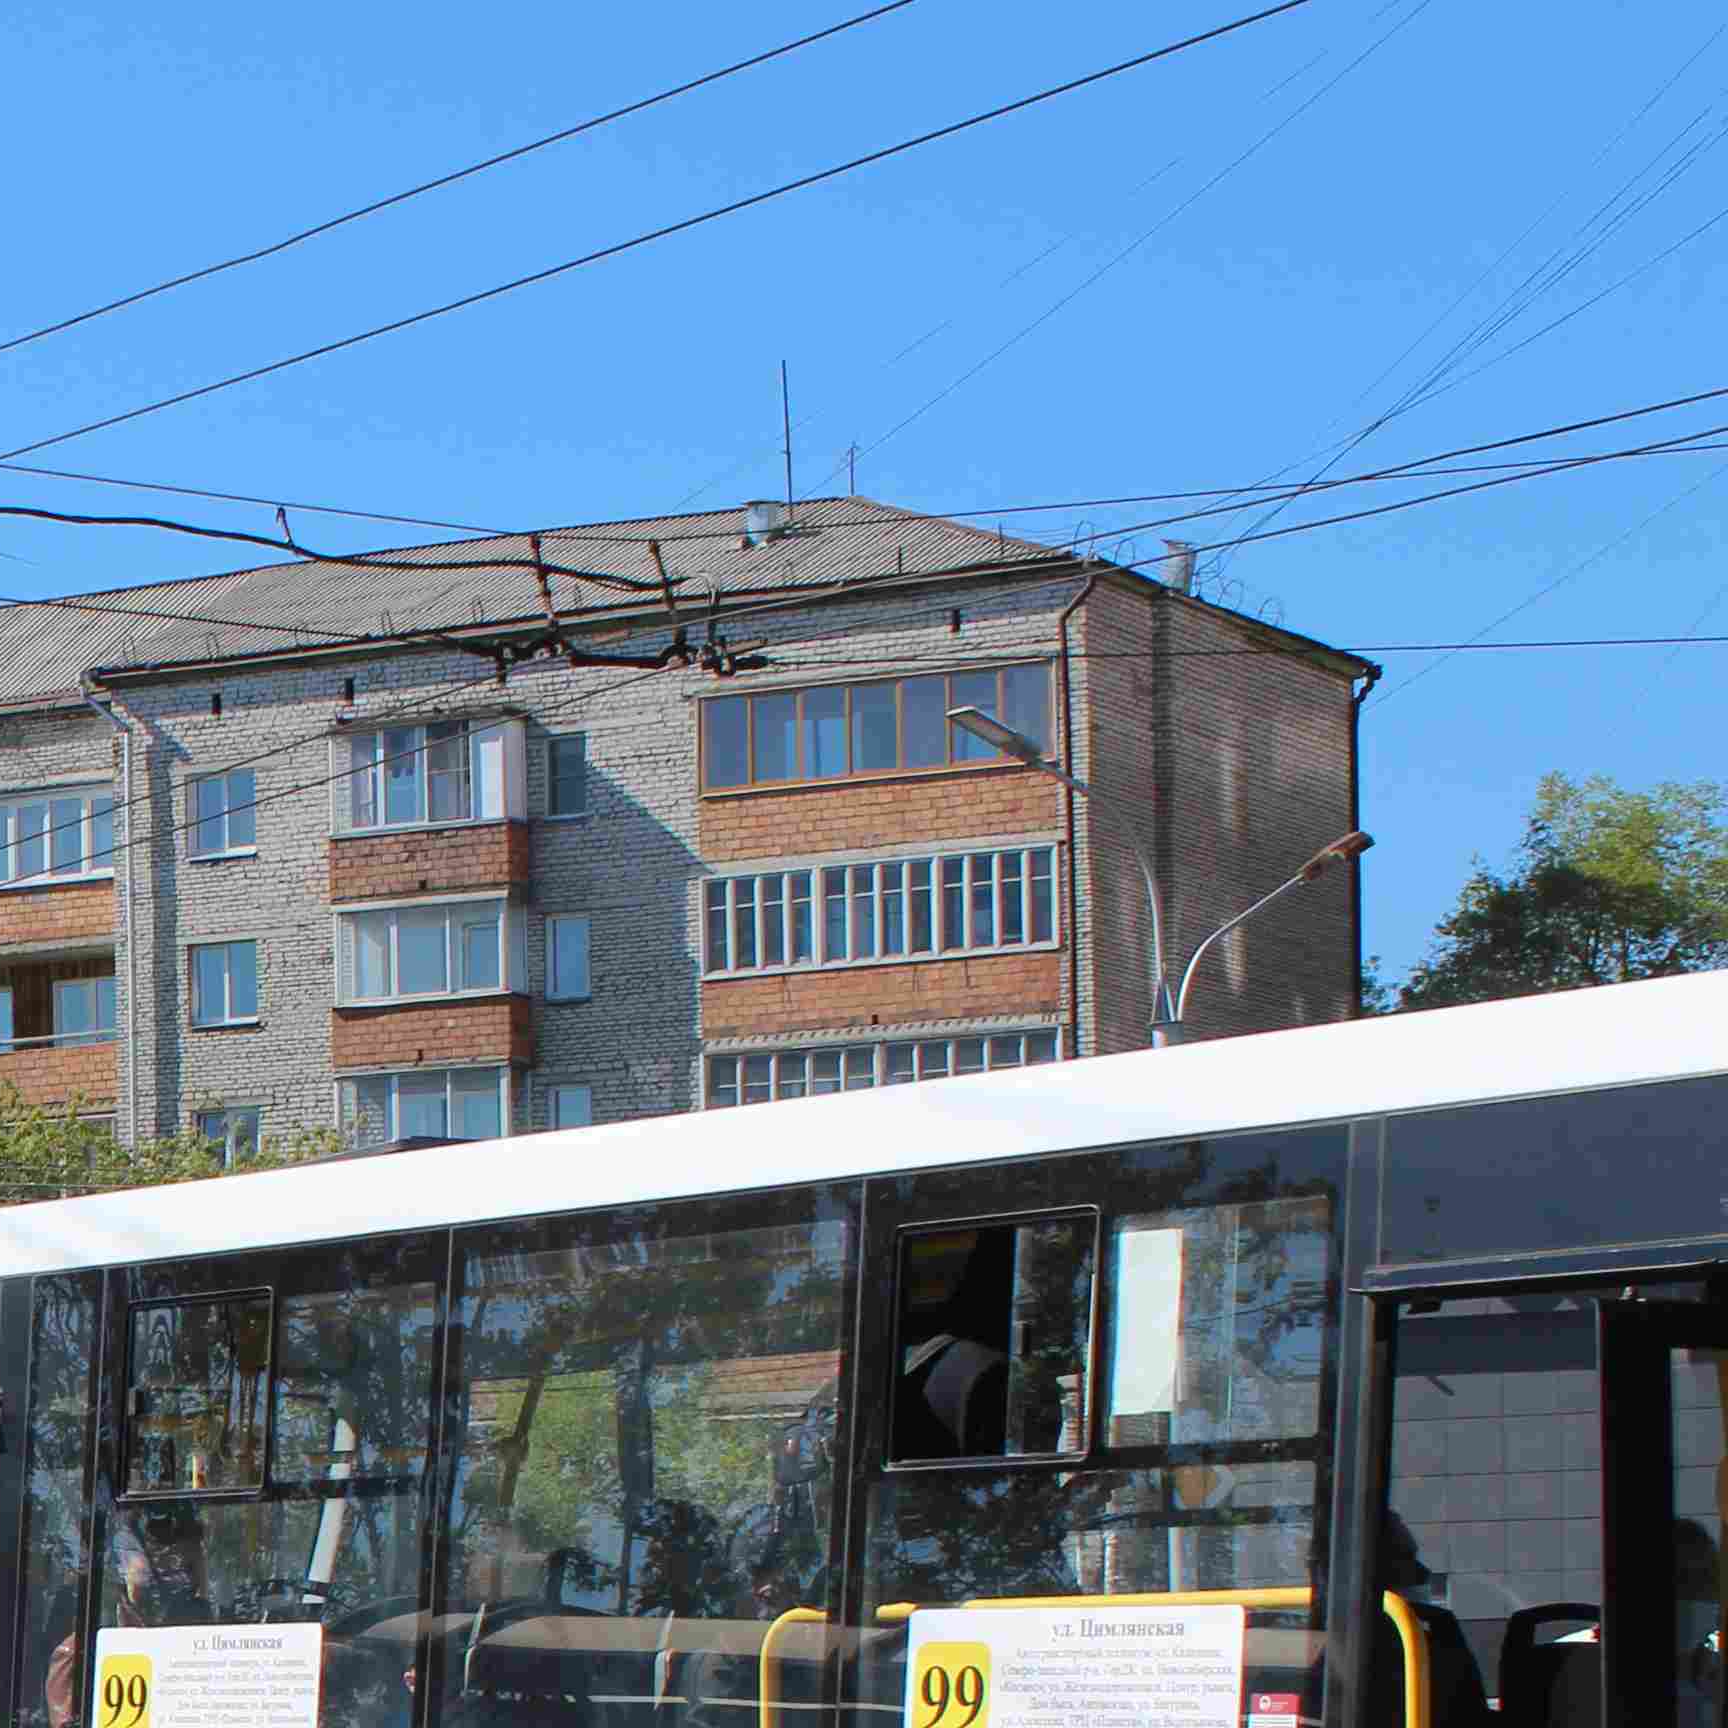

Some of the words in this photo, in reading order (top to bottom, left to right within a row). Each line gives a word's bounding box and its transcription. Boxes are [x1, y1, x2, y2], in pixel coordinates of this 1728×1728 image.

[1080, 1618, 1185, 1640] Цимлянская
[211, 1634, 283, 1652] Цимлянская
[104, 1673, 148, 1728] 99
